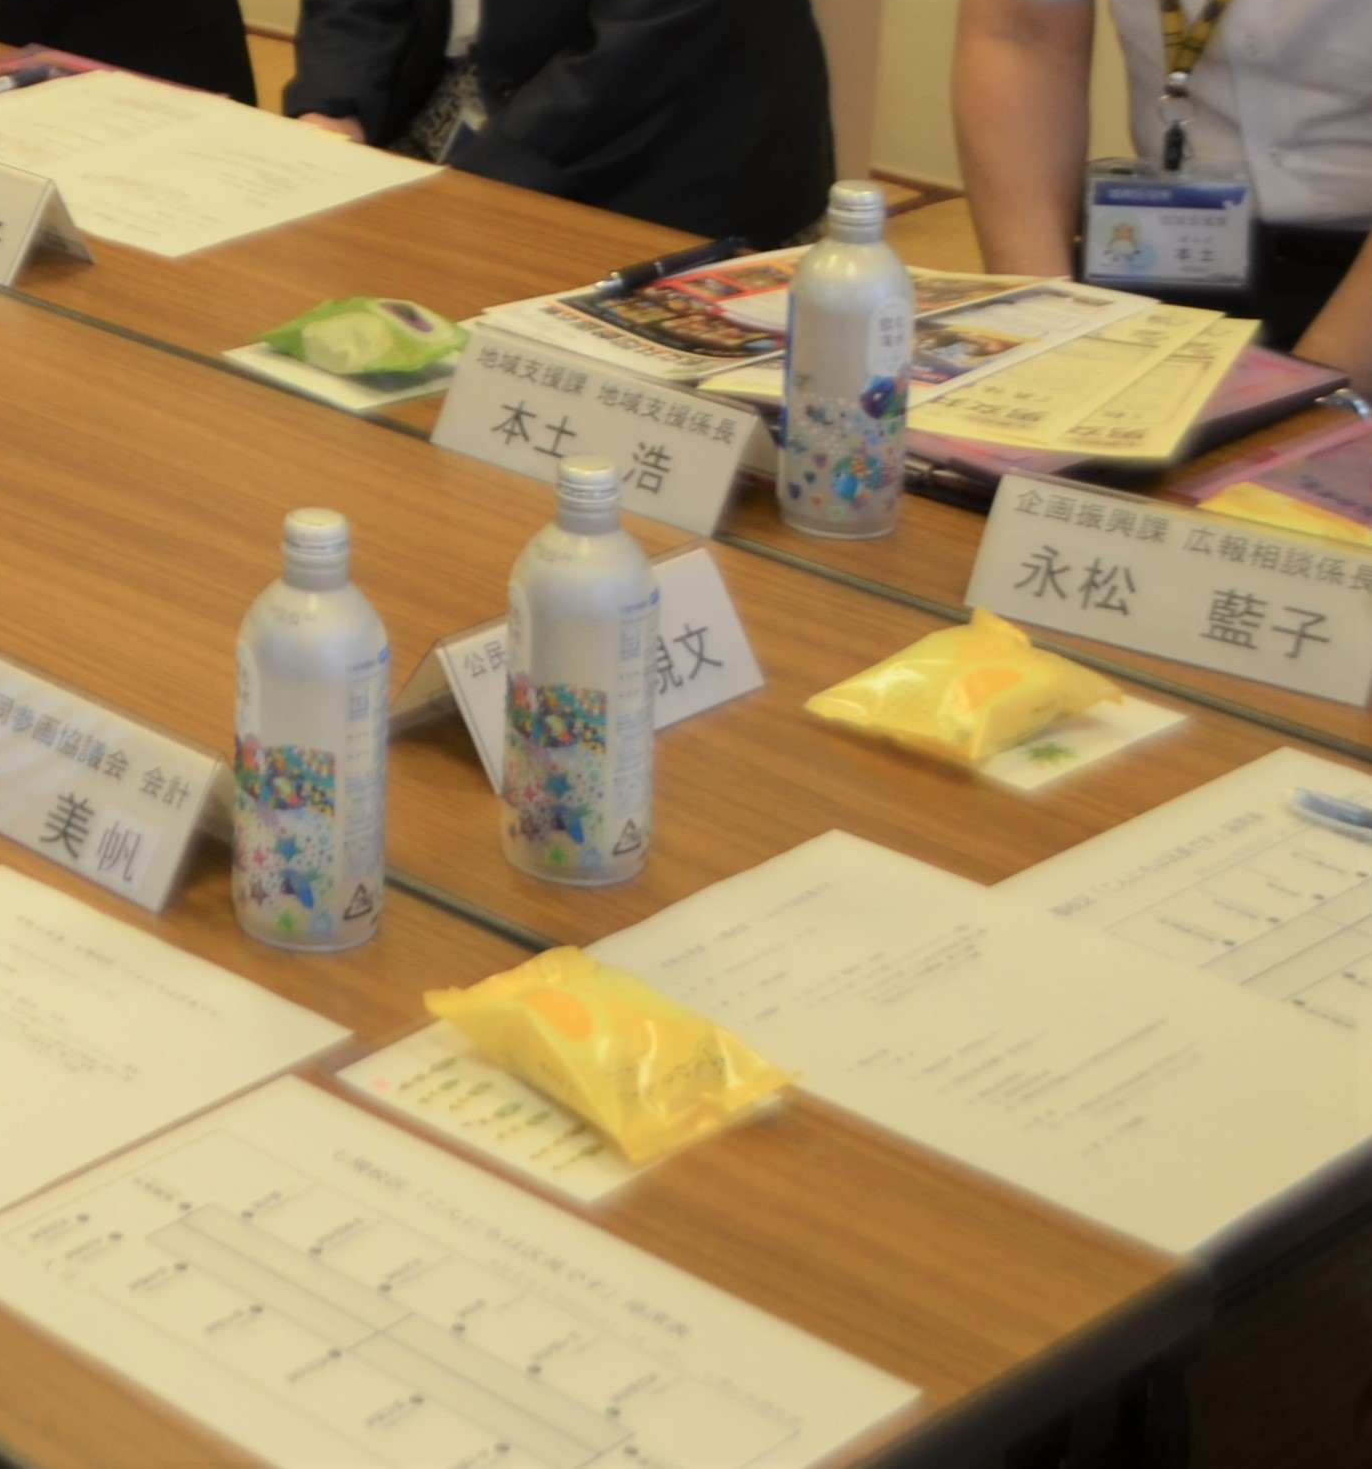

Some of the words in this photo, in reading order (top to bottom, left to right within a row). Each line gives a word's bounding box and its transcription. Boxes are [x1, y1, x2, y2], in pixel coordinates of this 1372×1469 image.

[476, 345, 589, 396] 地域支援課
[595, 382, 739, 446] 地域支援係長
[491, 400, 578, 460] 本土
[622, 441, 672, 495] 浩
[1013, 487, 1170, 544] 企画振興課
[1182, 525, 1372, 594] 広報相談係長
[1013, 544, 1139, 617] 永松
[1199, 588, 1331, 660] 藍子
[39, 790, 145, 883] 美帆
[138, 766, 193, 811] 会計
